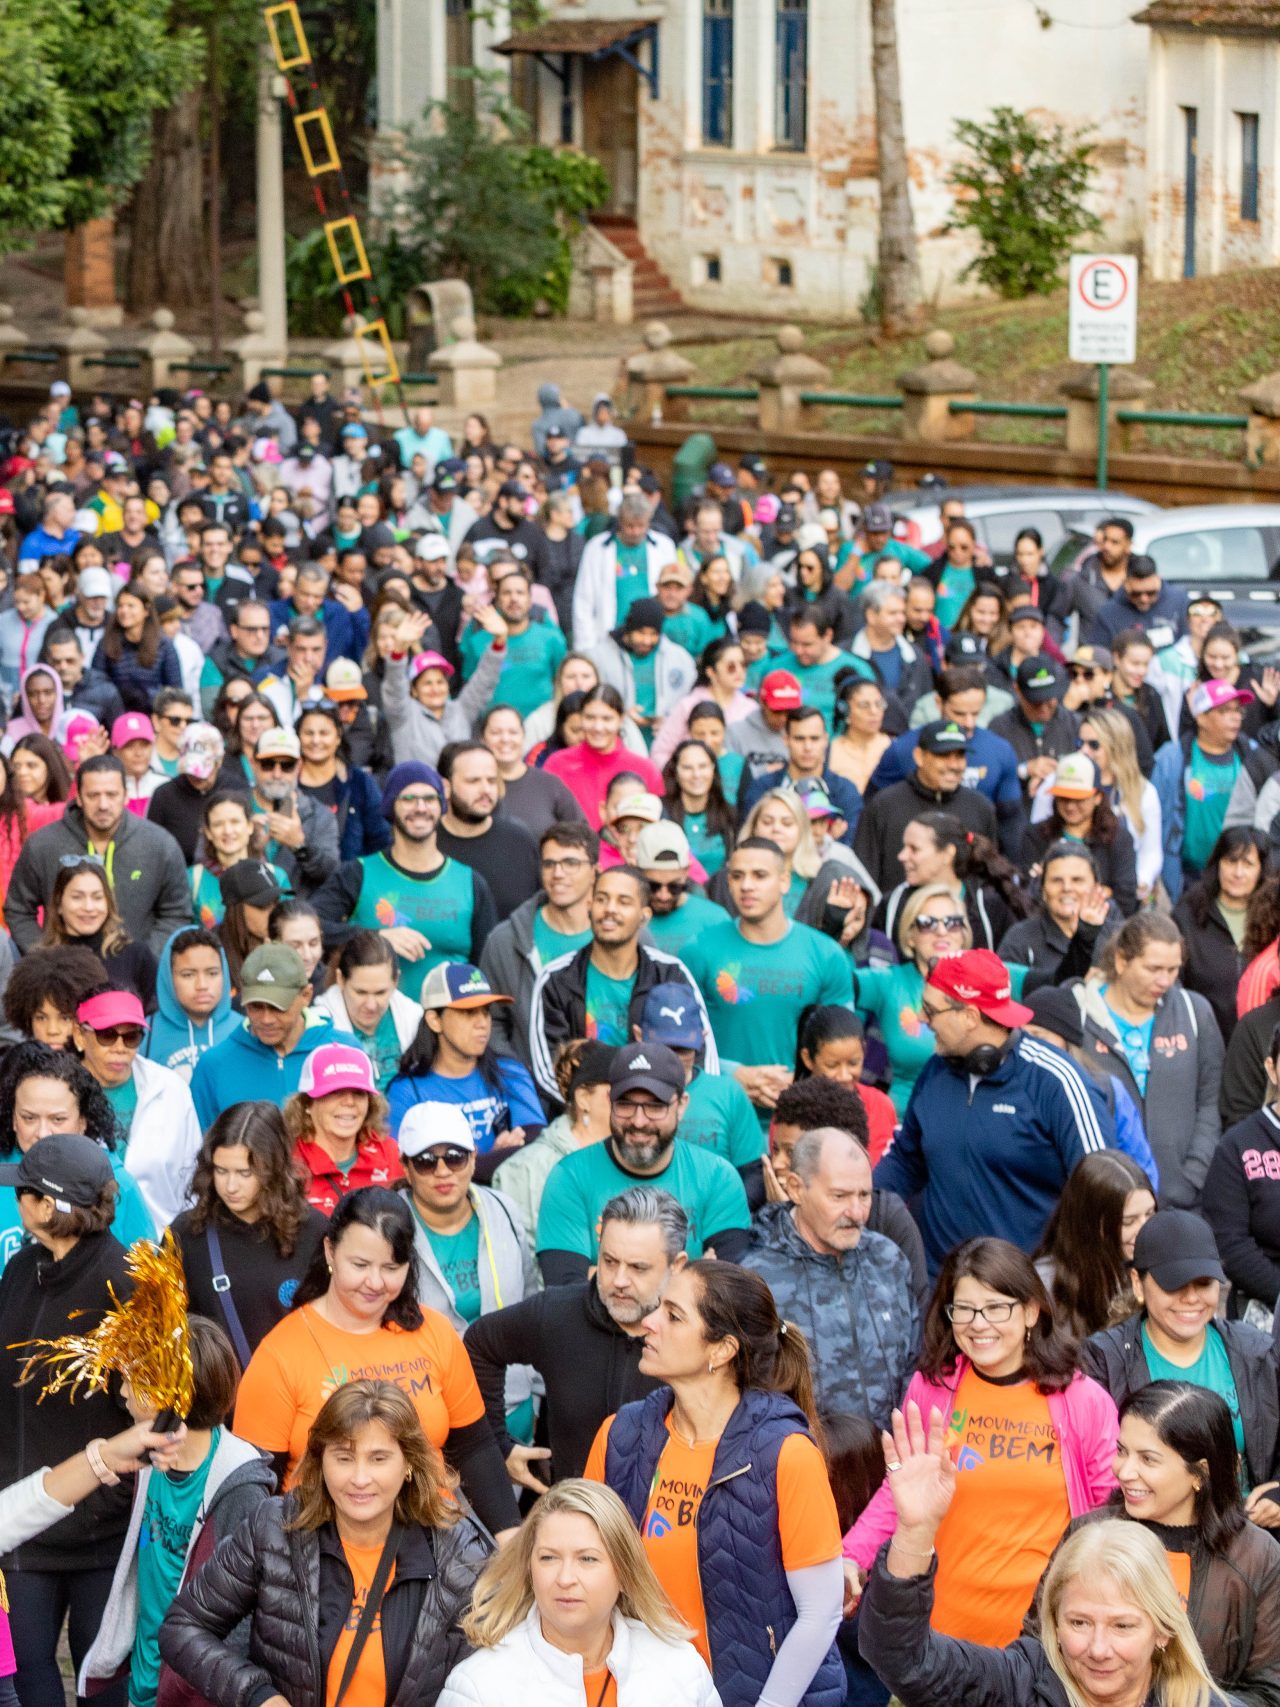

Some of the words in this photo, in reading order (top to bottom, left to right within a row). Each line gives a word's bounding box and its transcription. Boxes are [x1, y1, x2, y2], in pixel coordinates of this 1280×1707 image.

[1094, 269, 1111, 300] E
[759, 978, 803, 999] BEM
[1242, 1148, 1280, 1181] 28
[350, 1357, 432, 1379] MOVIMENTO
[395, 1374, 433, 1398] EM
[968, 1415, 1058, 1440] MOVIMENTO
[966, 1432, 985, 1445] DO
[989, 1433, 1055, 1464] BEM
[656, 1496, 675, 1511] DO
